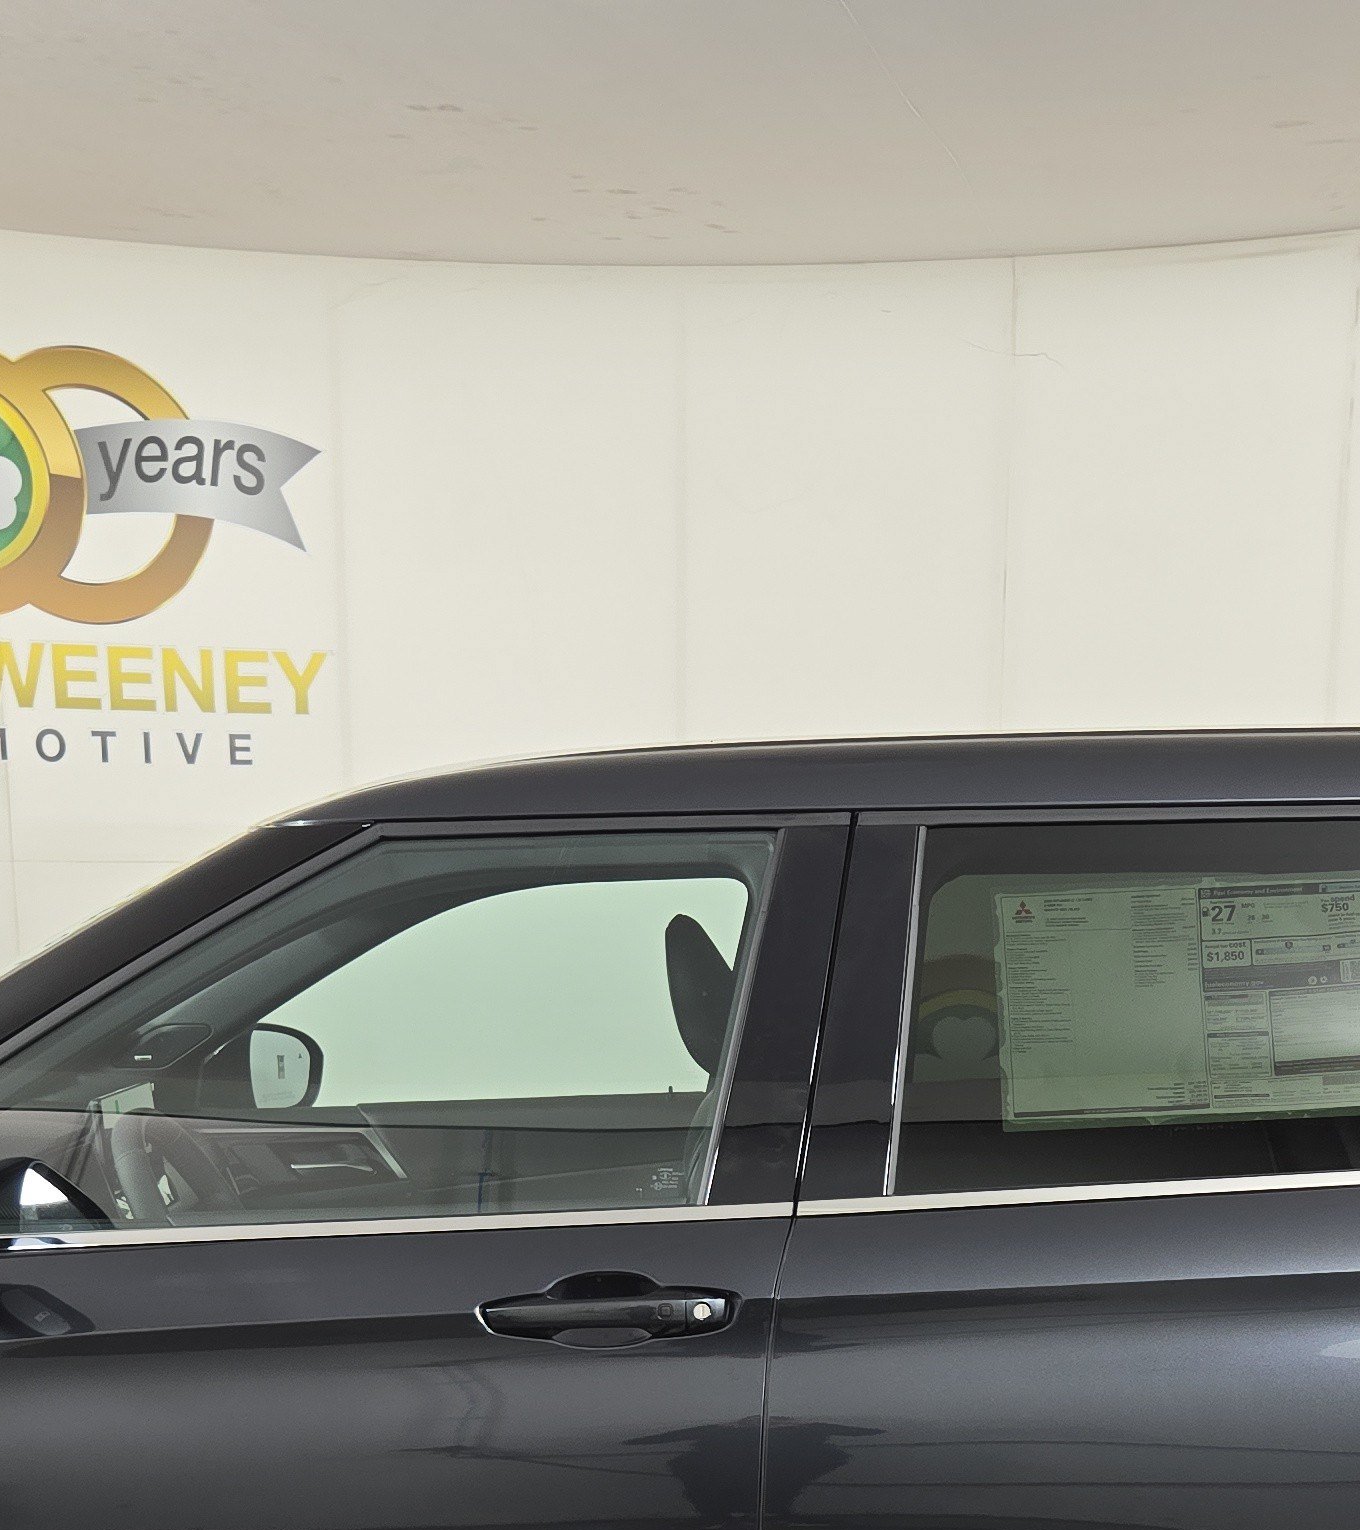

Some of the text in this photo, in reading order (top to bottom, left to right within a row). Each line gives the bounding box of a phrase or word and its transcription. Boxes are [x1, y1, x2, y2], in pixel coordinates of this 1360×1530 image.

[97, 428, 267, 501] years
[1210, 904, 1237, 922] 27
[1321, 902, 1350, 914] $750
[1206, 950, 1245, 963] $1,850
